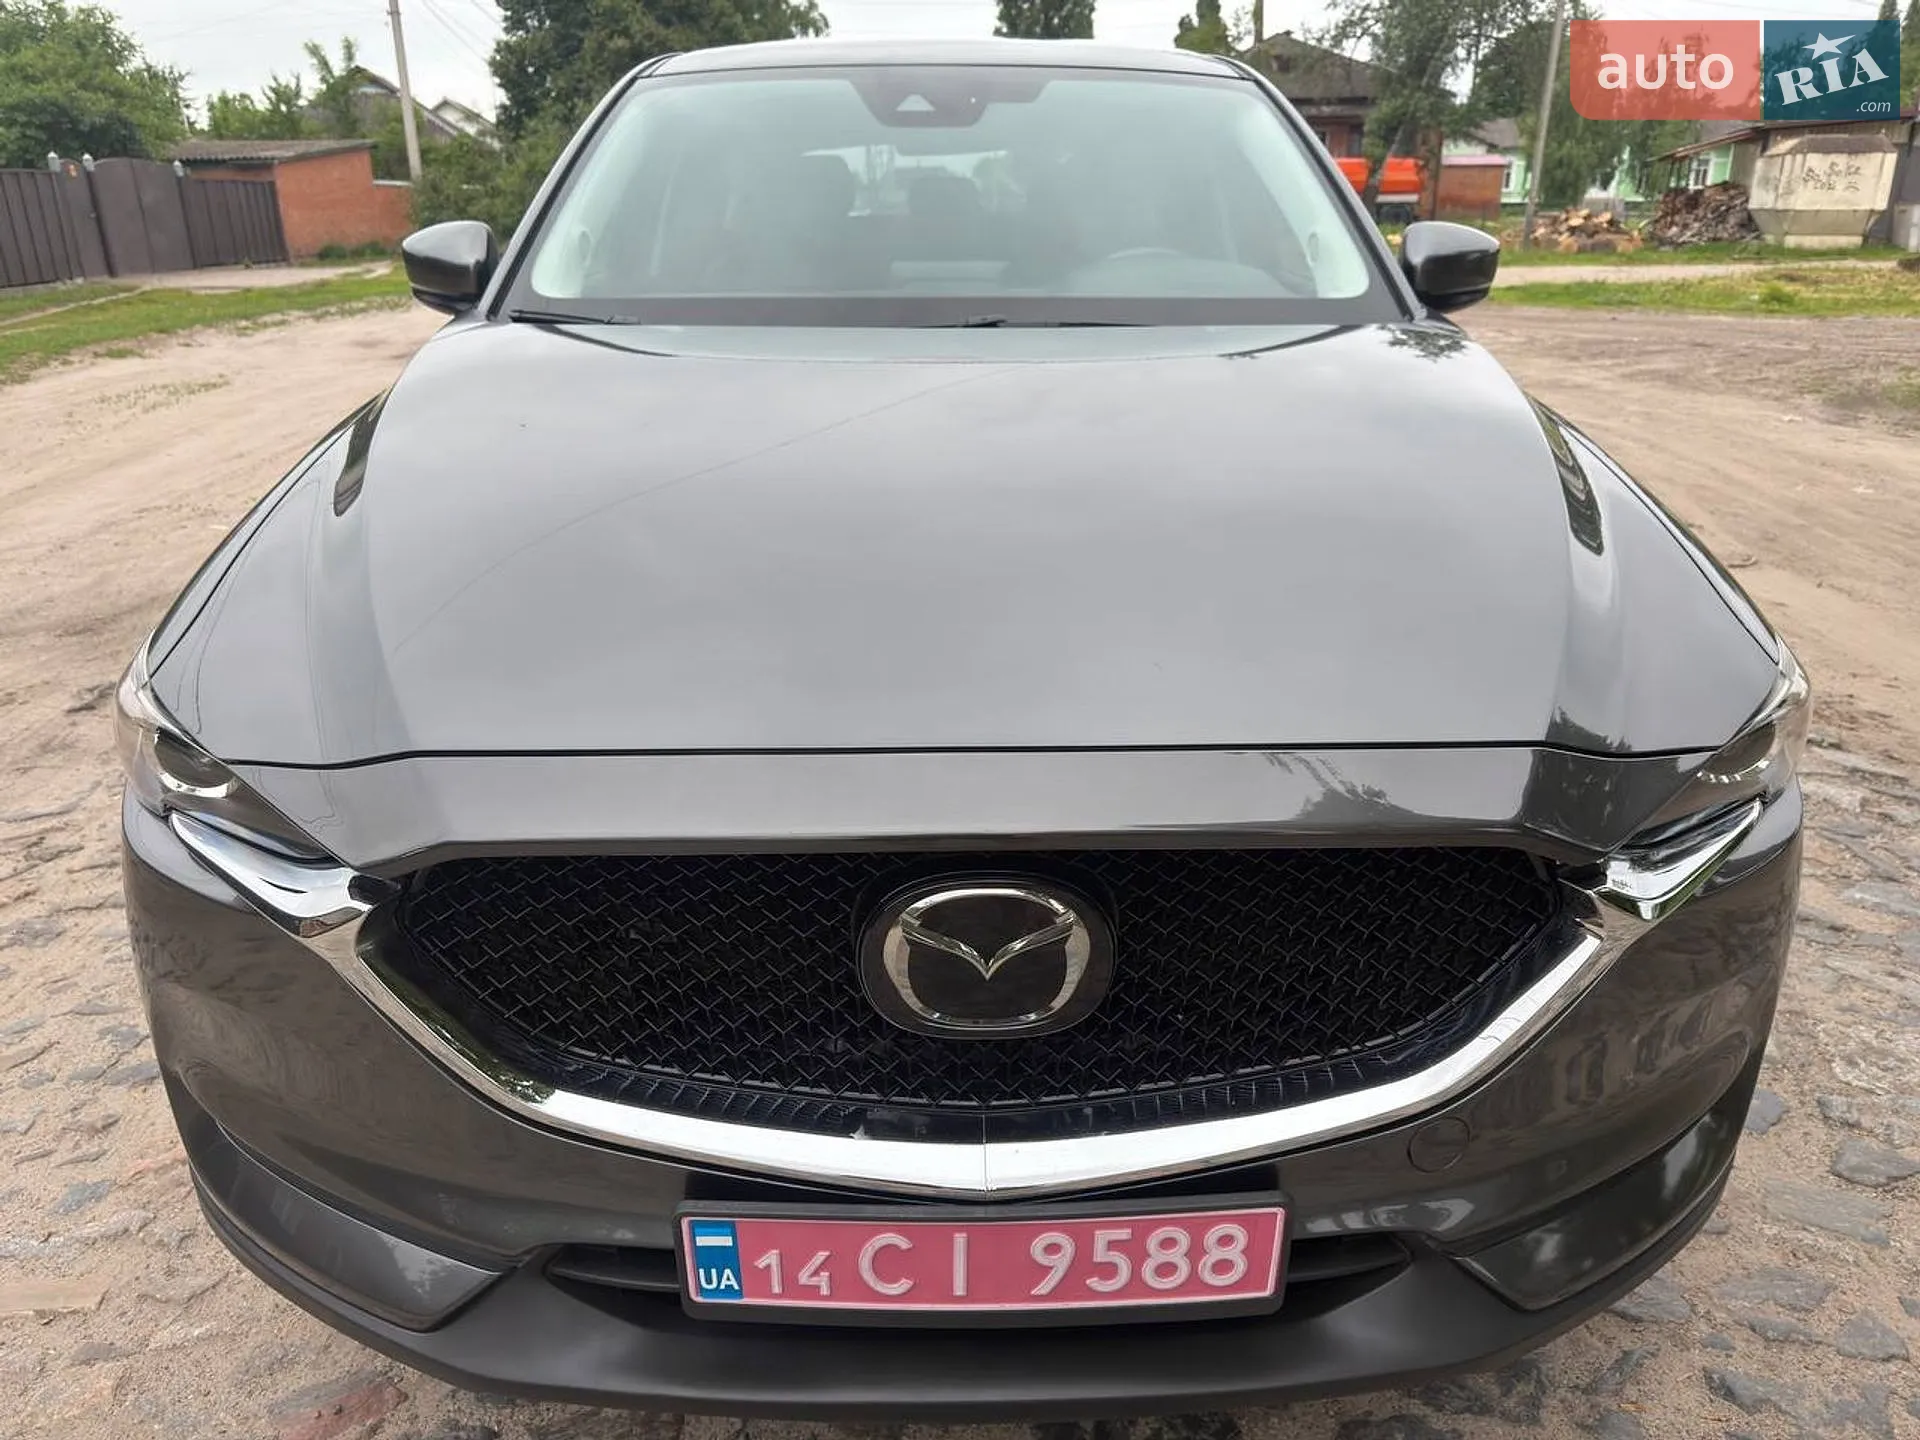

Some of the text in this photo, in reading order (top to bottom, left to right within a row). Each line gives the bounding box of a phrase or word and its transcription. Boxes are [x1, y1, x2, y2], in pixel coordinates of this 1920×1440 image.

[698, 1267, 740, 1290] UA
[753, 1248, 832, 1297] 14
[1029, 1222, 1249, 1297] 9588
